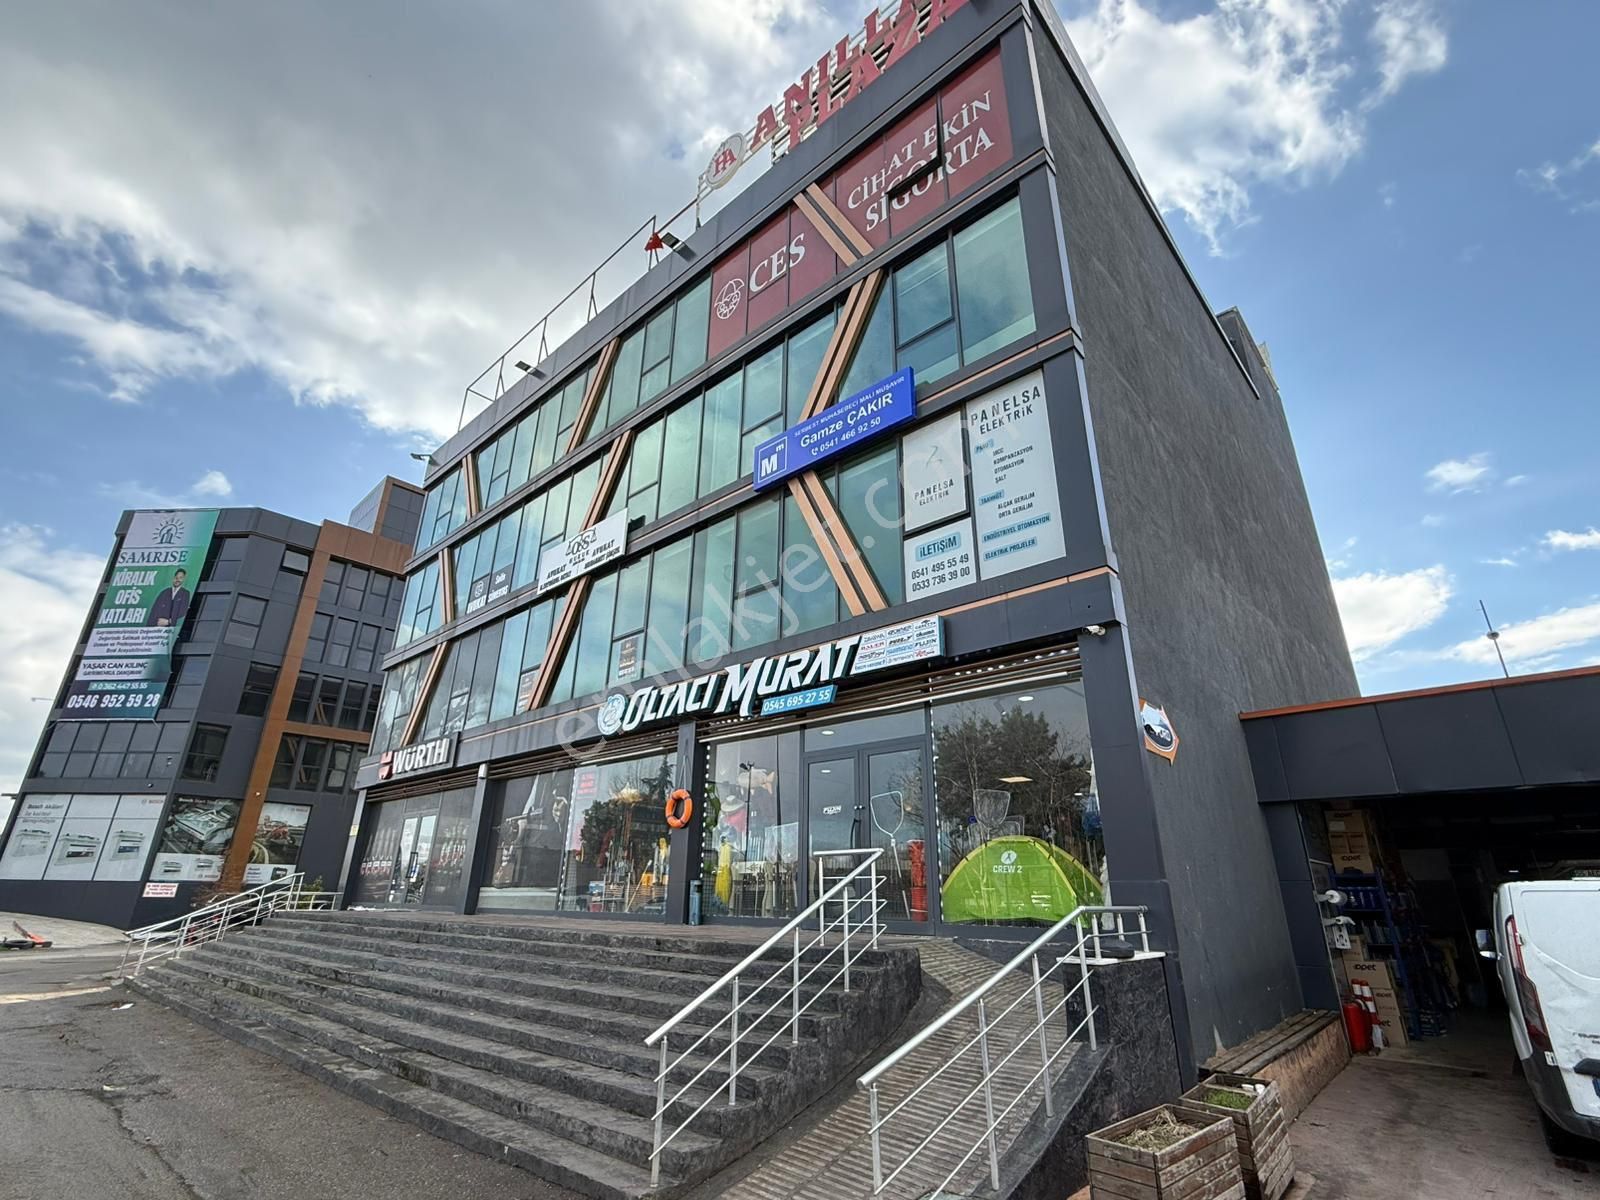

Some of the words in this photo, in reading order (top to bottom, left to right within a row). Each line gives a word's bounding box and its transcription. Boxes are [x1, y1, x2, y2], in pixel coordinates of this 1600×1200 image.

[847, 139, 917, 209] CİHAT
[922, 90, 991, 149] EKİN
[749, 233, 806, 292] CES
[971, 386, 1041, 426] PANELSA
[800, 420, 843, 448] Gamze
[847, 392, 894, 427] ÇAKIR
[820, 438, 839, 453] 0541
[841, 429, 856, 442] 466
[858, 422, 869, 434] 92
[870, 416, 882, 428] 50
[914, 478, 954, 501] PANELSA
[118, 550, 189, 564] SAMRISE
[911, 566, 929, 580] 0541
[931, 561, 946, 574] 495
[947, 556, 958, 568] 55
[959, 553, 970, 564] 49
[112, 568, 158, 586] KİRALIK
[912, 579, 931, 592] 0533
[932, 573, 947, 586] 736
[948, 569, 959, 581] 39
[960, 565, 971, 577] 00
[115, 586, 142, 605] OFİS
[98, 607, 147, 625] KATLARI
[623, 674, 719, 731] OLTACI
[714, 635, 862, 717] MURAT
[67, 694, 100, 709] 0546
[100, 694, 126, 708] 952
[126, 693, 144, 708] 59
[144, 692, 161, 707] 28
[763, 698, 785, 712] 0545
[786, 695, 804, 707] 695
[804, 691, 817, 704] 27
[818, 689, 830, 701] 55
[392, 738, 450, 774] WÜRTH
[992, 865, 1016, 873] CREW
[1016, 865, 1023, 873] 2
